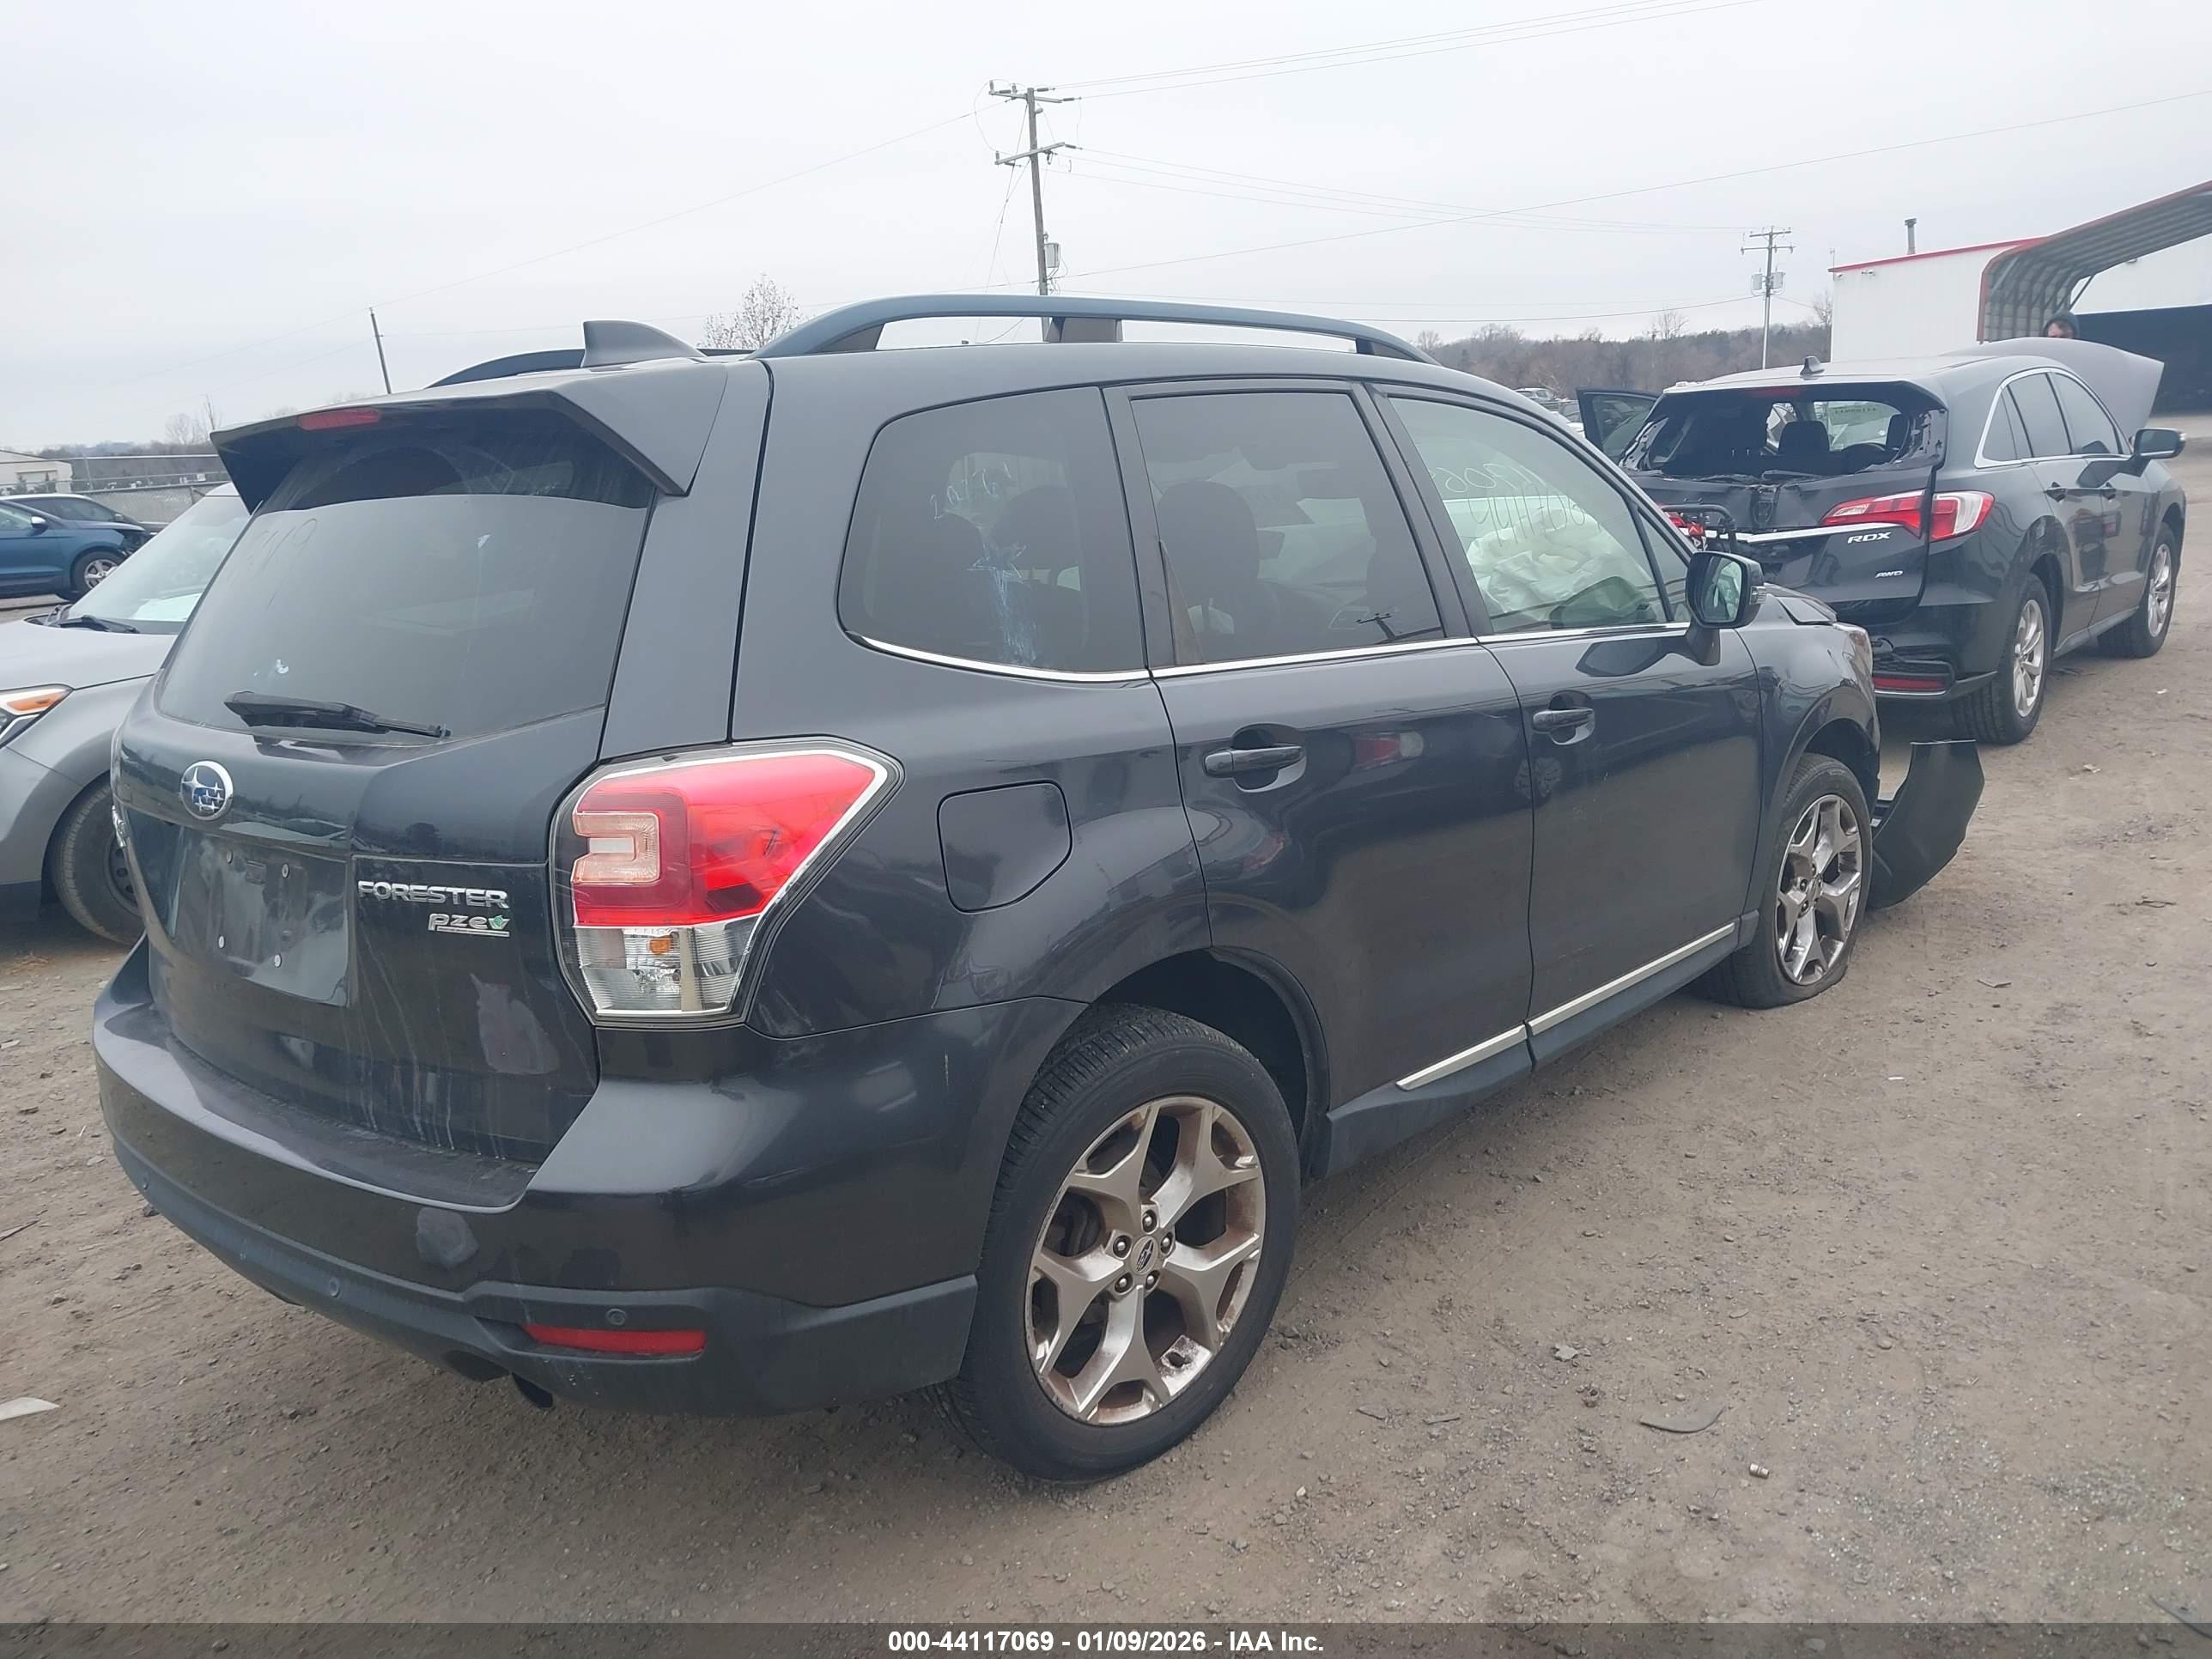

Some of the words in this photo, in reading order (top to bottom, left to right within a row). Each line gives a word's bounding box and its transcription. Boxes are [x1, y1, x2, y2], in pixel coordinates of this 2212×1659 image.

[1847, 532, 1892, 544] RDX
[1875, 570, 1904, 579] AWD
[357, 880, 510, 908] FORESTER
